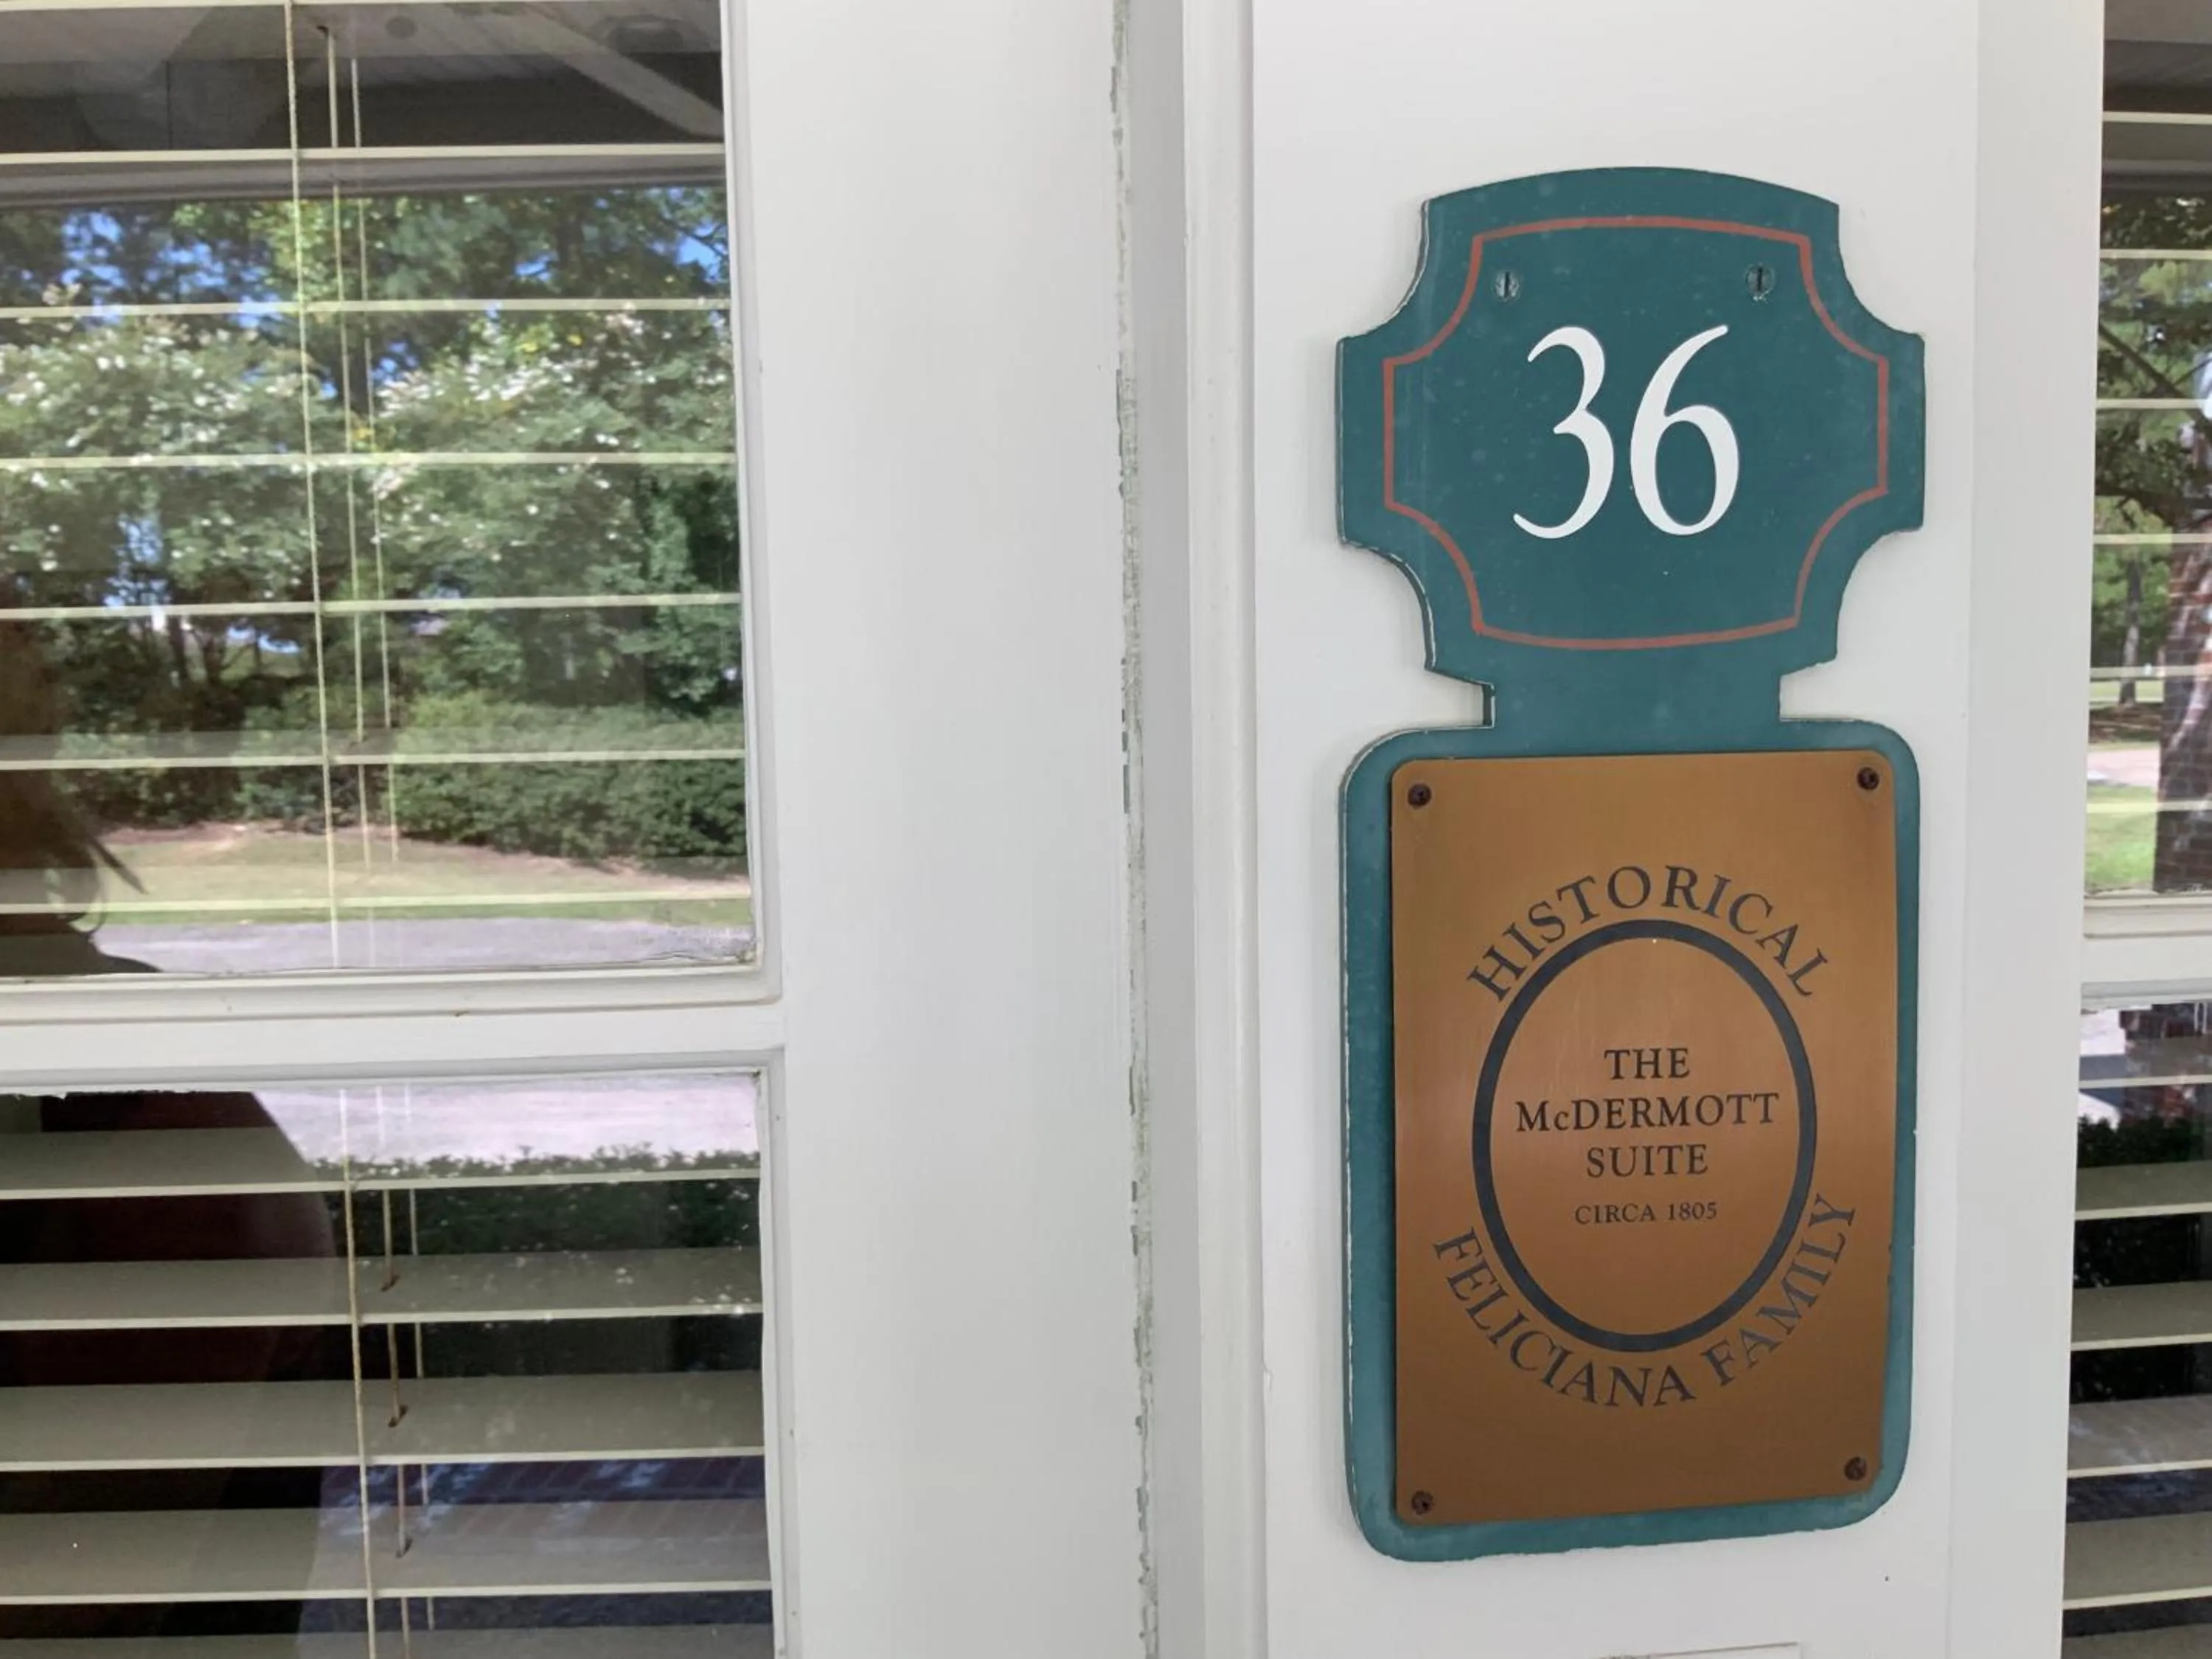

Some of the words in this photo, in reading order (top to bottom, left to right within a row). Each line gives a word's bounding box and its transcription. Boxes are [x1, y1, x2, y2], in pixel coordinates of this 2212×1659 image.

[1512, 324, 1739, 539] 36
[1467, 864, 1829, 1003] HISTORICAL
[1604, 1047, 1690, 1080] THE
[1515, 1091, 1780, 1133] McDERMOTT
[1586, 1143, 1709, 1178] SUITE
[1574, 1203, 1658, 1225] CIRCA
[1666, 1201, 1718, 1222] 1805
[1433, 1227, 1697, 1408] FELICIANA
[1700, 1193, 1856, 1388] FAMILY
